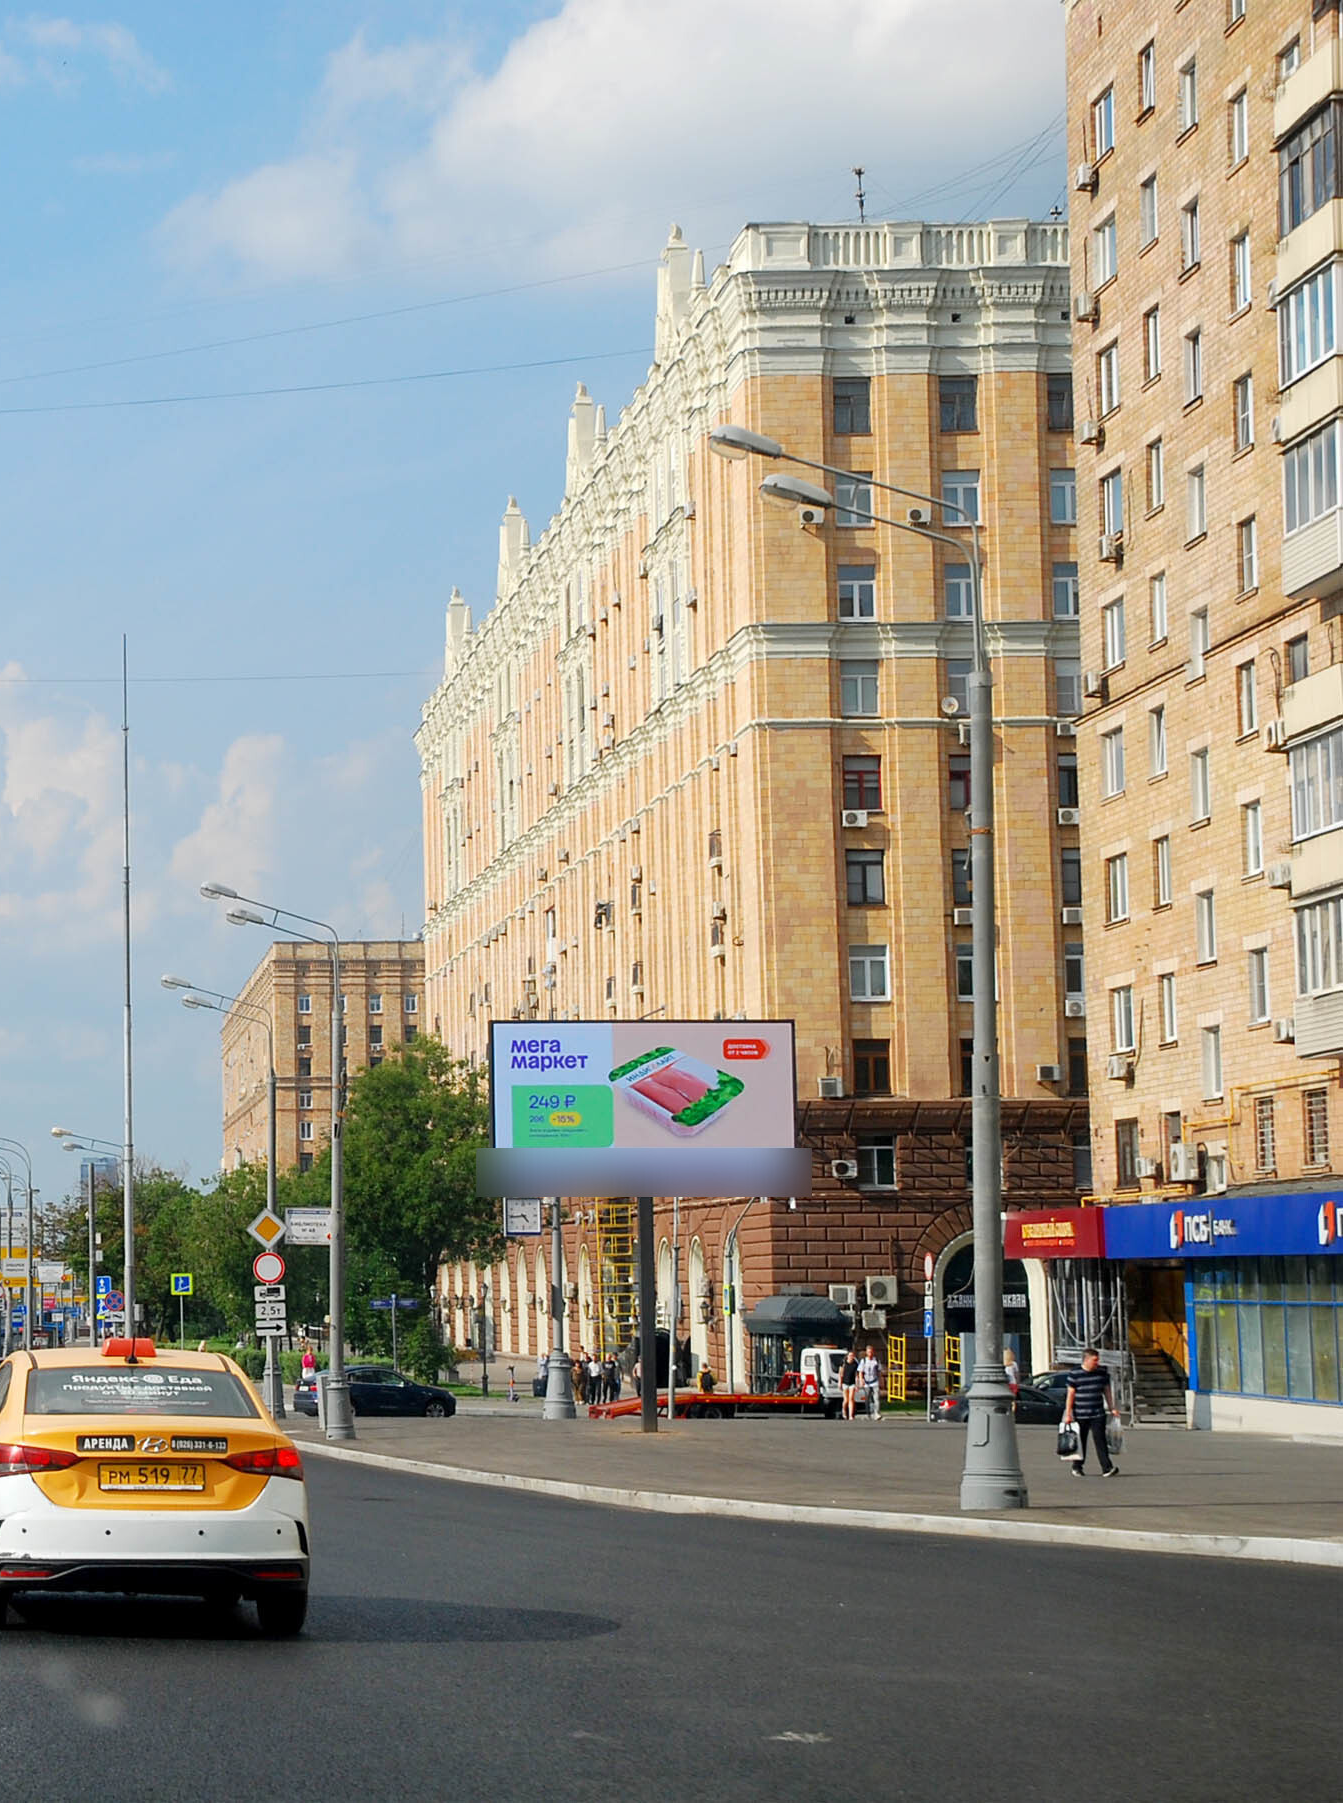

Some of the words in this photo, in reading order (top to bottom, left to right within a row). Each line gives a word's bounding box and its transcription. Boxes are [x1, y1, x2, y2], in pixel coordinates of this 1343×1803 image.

[510, 1039, 561, 1053] мега
[510, 1055, 588, 1072] маркет
[528, 1094, 560, 1109] 249
[71, 1374, 140, 1384] Яндекс
[167, 1374, 203, 1384] Еда
[83, 1438, 129, 1450] АРЕНДА
[109, 1471, 130, 1484] РМ
[138, 1467, 170, 1484] 519
[181, 1466, 198, 1480] 77
